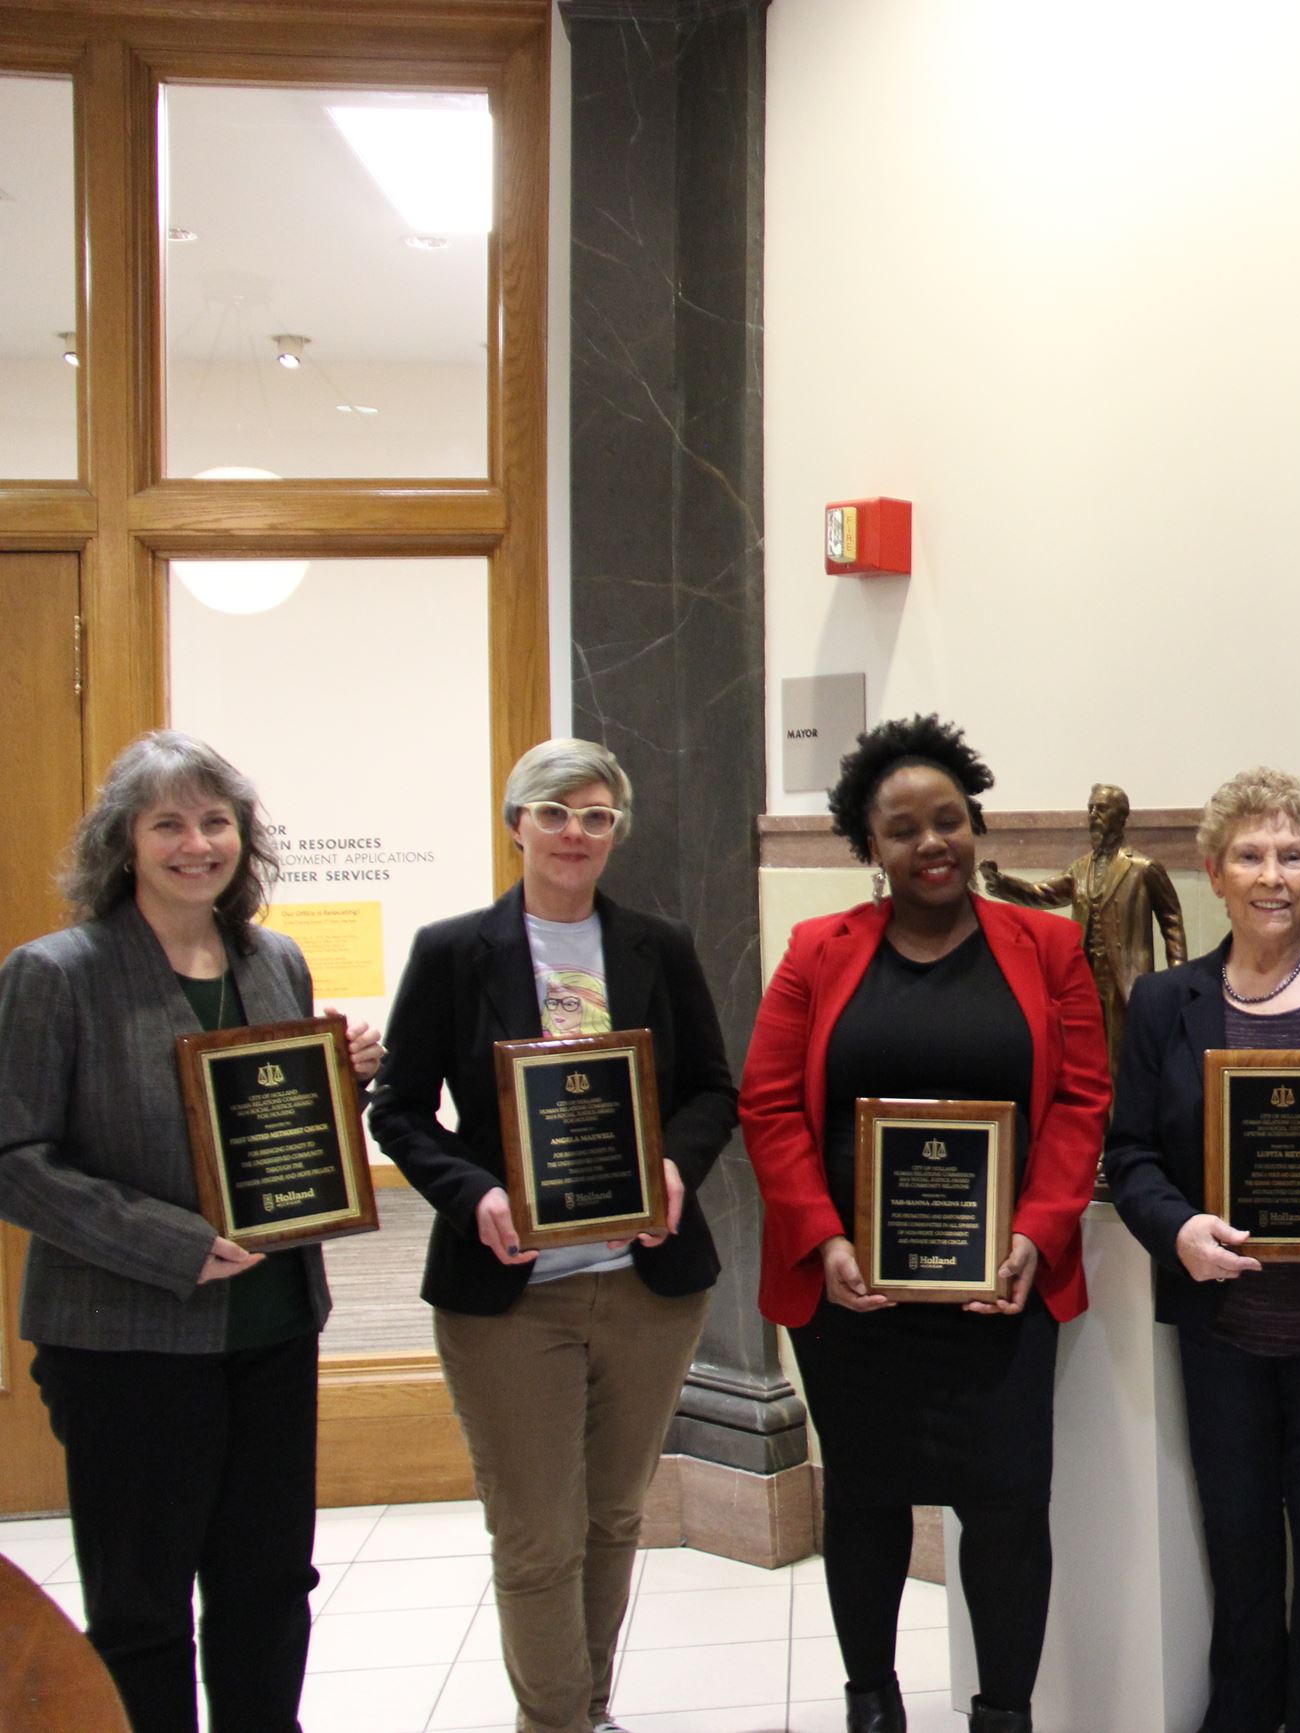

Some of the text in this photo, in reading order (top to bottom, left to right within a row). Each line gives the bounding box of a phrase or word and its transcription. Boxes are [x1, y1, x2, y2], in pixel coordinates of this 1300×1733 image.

[787, 728, 818, 739] MAYOR
[299, 837, 382, 850] RESOURCES
[345, 851, 434, 864] APPLICATIONS
[326, 869, 390, 881] SERVICES
[274, 1187, 315, 1203] Holland
[575, 1189, 613, 1202] Holland
[920, 1256, 957, 1264] Holland
